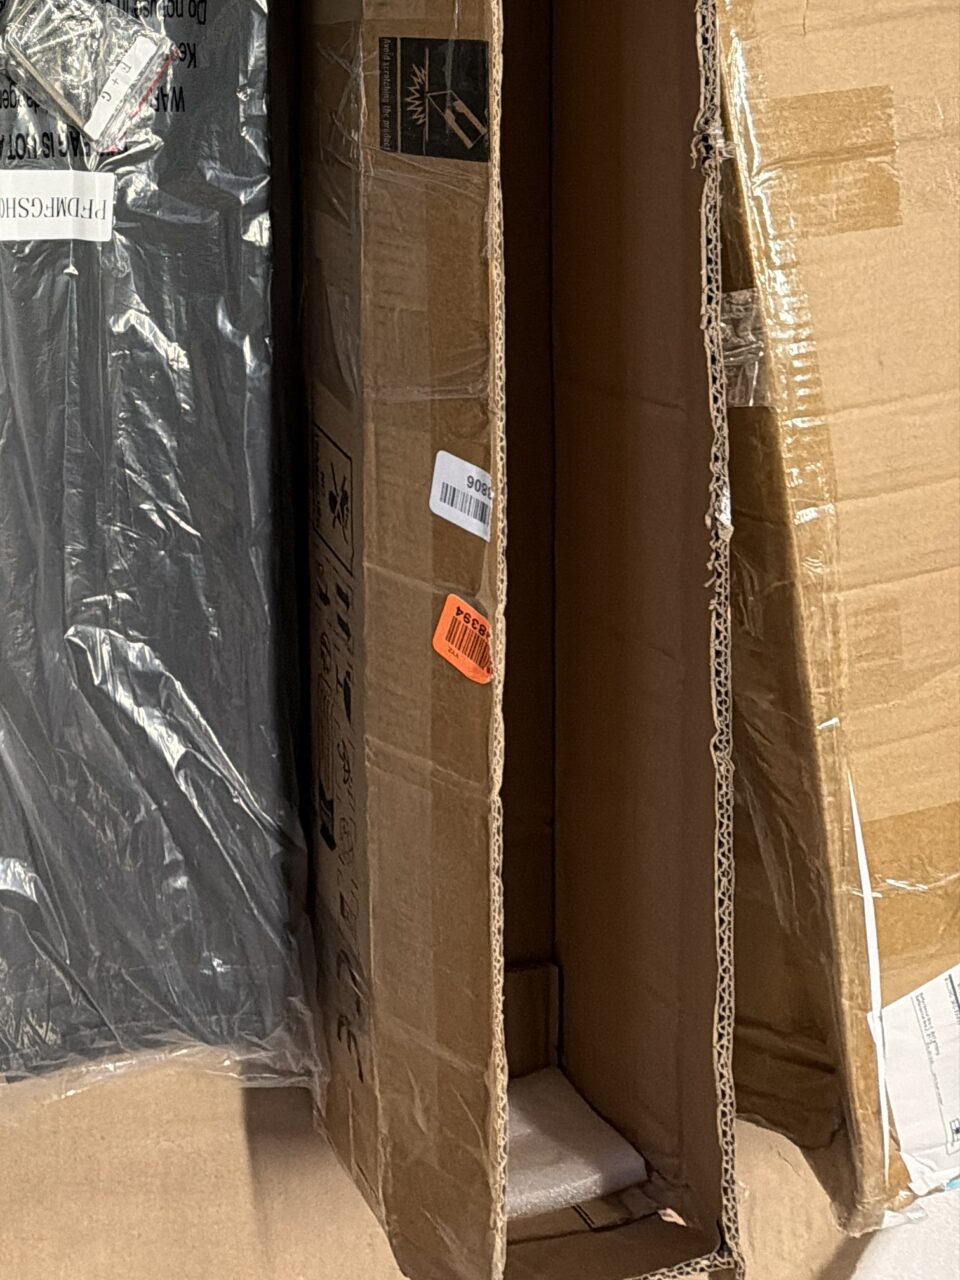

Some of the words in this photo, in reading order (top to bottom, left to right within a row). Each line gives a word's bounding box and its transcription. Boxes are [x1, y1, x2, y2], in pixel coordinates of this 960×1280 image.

[382, 38, 392, 60] Avoid
[380, 61, 392, 104] scratching
[98, 89, 113, 103] G
[382, 104, 392, 119] the
[41, 131, 55, 158] IS
[381, 119, 391, 150] product
